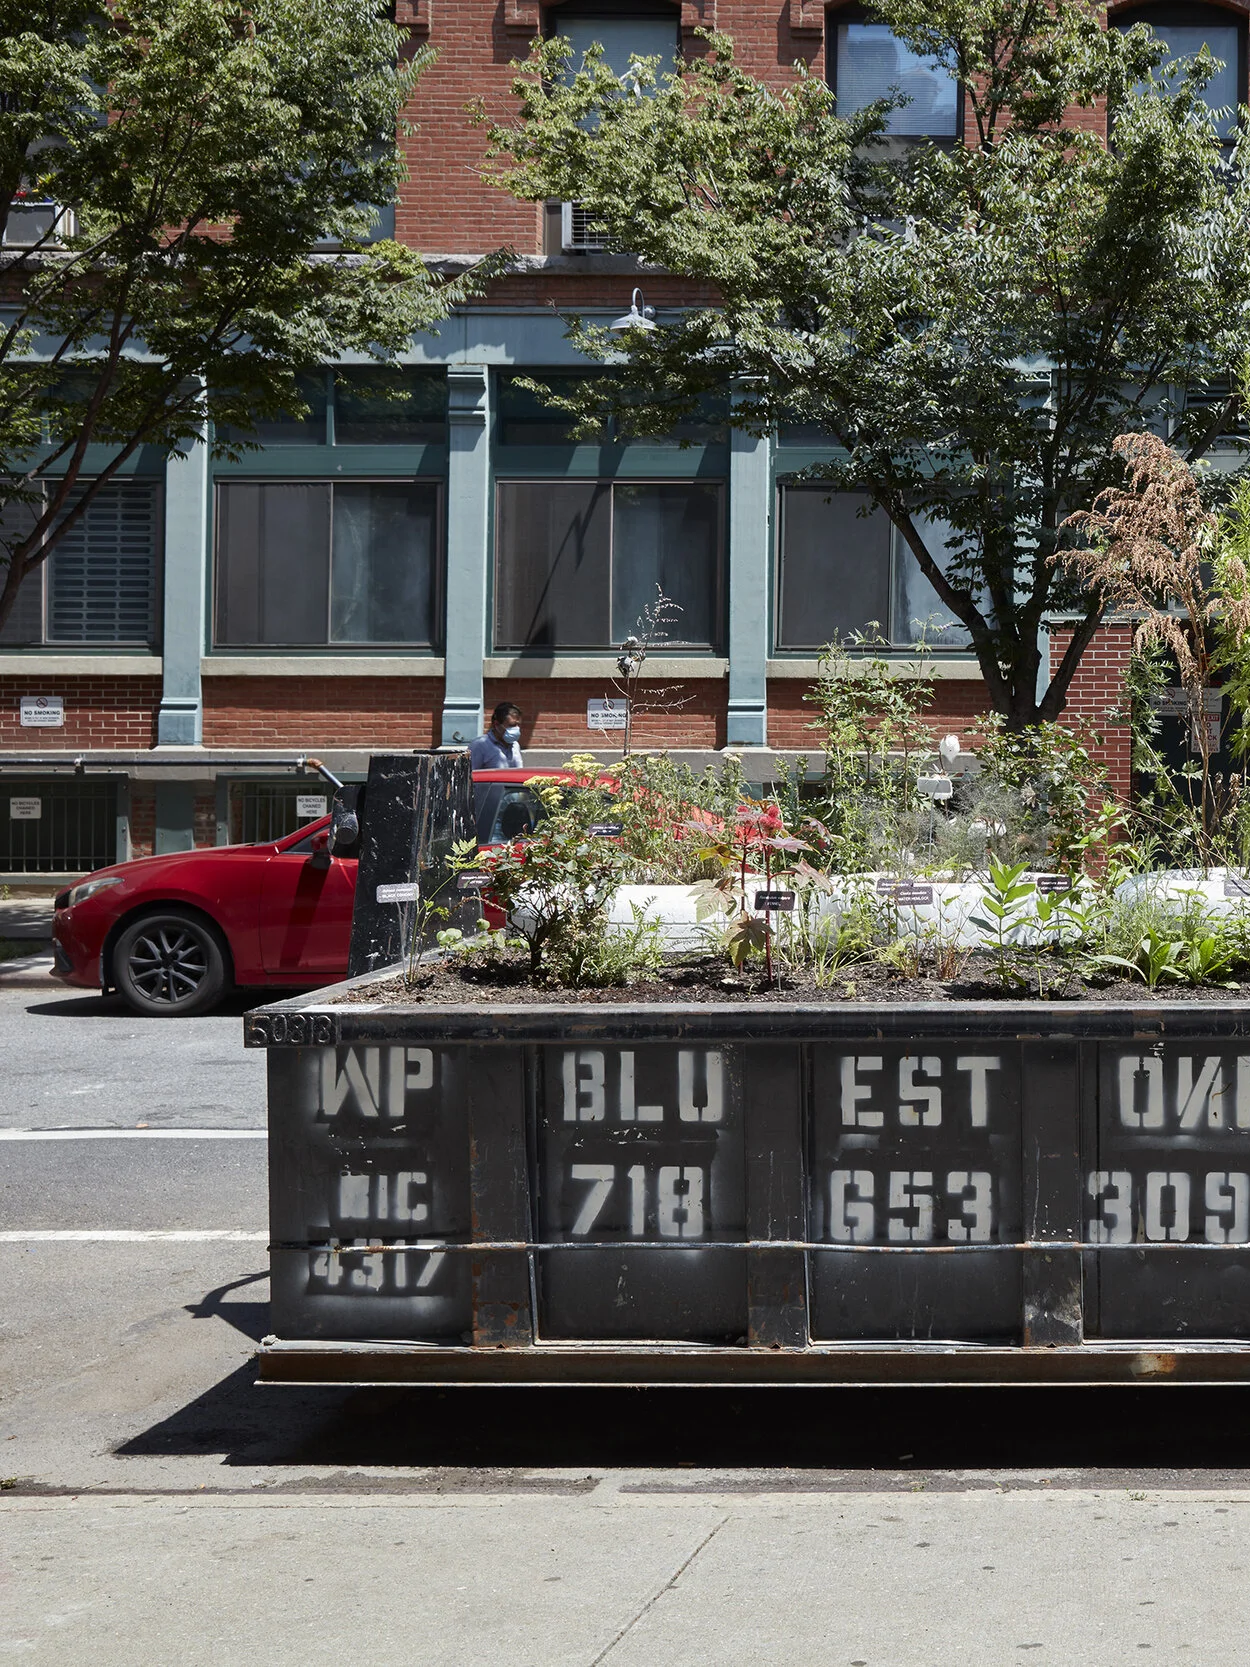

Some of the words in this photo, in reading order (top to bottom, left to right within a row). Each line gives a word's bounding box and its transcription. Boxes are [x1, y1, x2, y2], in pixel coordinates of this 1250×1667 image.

[321, 1046, 434, 1117] WP
[562, 1050, 724, 1122] BLU
[840, 1055, 1001, 1127] EST
[571, 1163, 704, 1236] 718
[829, 1169, 992, 1242] 653
[313, 1238, 448, 1290] 4317
